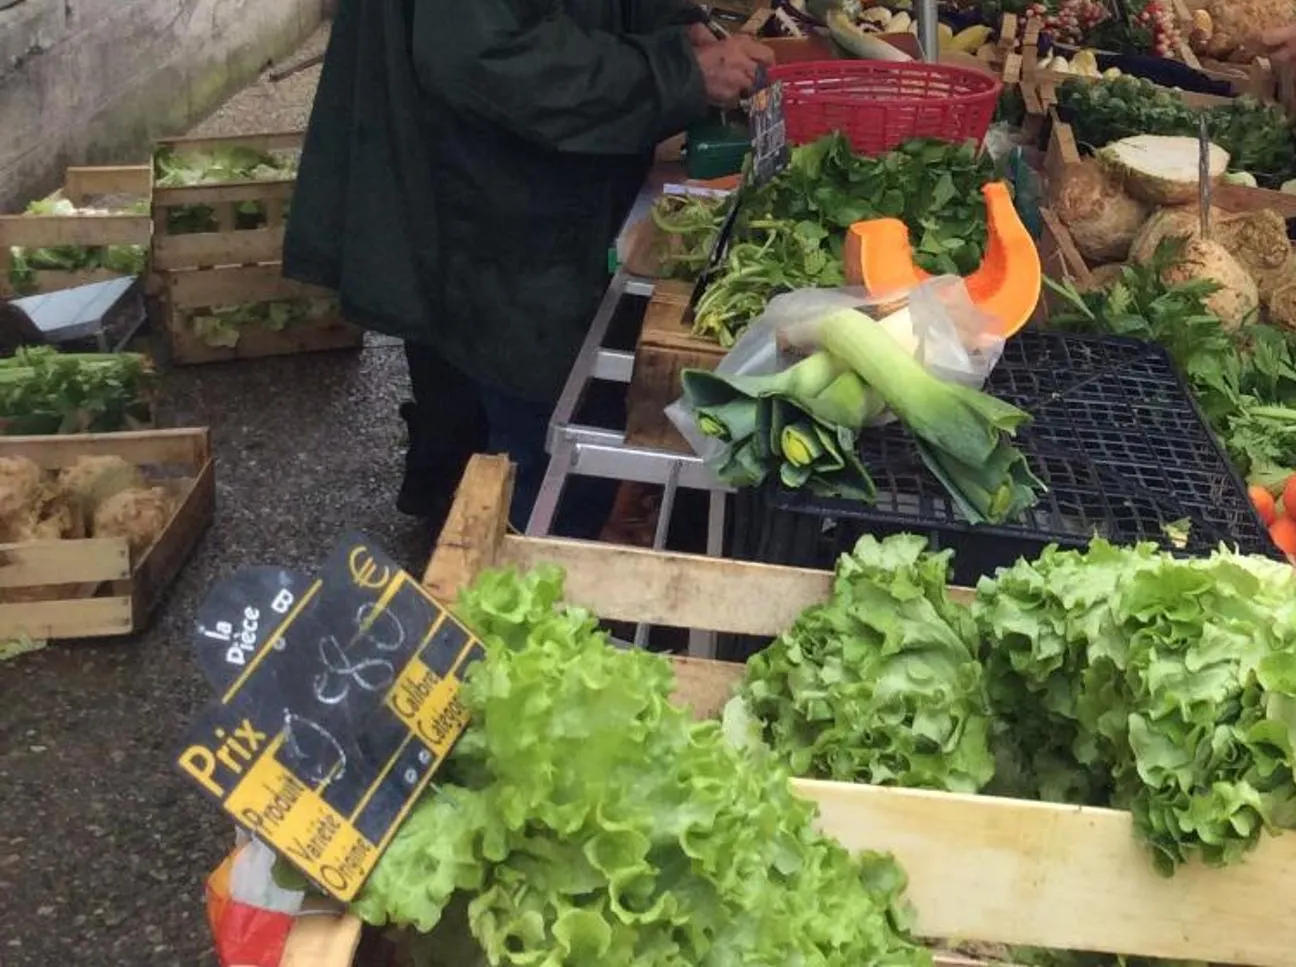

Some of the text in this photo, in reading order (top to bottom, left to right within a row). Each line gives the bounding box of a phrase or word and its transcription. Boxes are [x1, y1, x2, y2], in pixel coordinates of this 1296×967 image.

[391, 671, 439, 718] Calibre
[416, 687, 465, 745] Catégor
[178, 718, 266, 798] Prix
[241, 773, 305, 837] Produit
[287, 805, 341, 864] Variété
[320, 836, 371, 891] Origine
